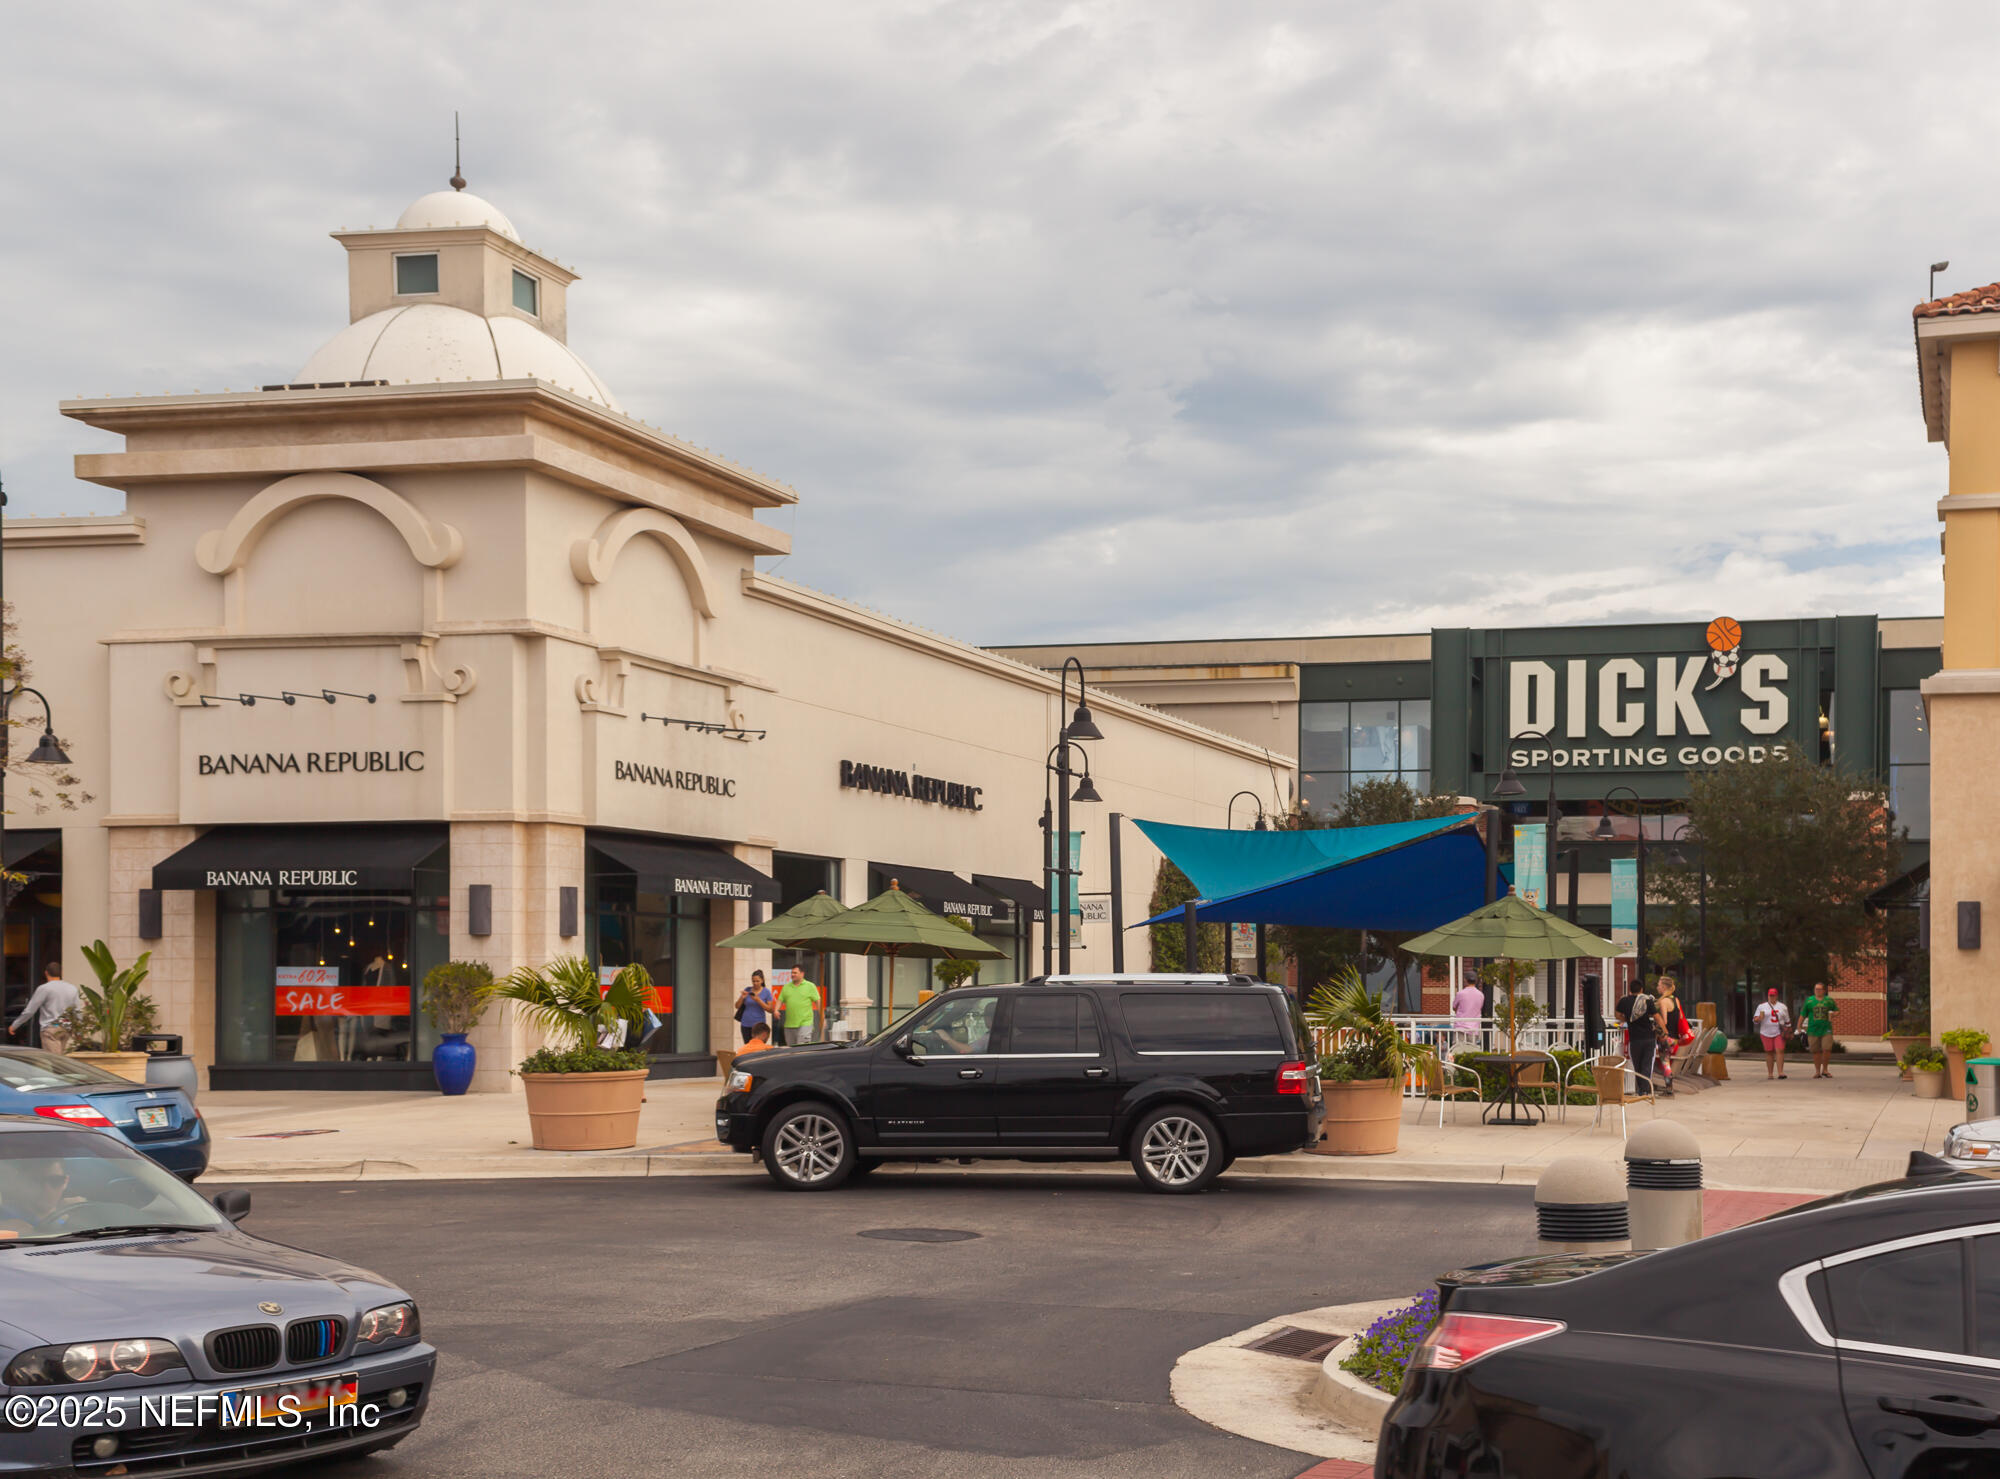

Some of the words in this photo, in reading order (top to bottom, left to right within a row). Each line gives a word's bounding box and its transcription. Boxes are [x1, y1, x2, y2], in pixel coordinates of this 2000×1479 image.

[1509, 654, 1789, 739] DICK'S
[199, 752, 301, 775] BANANA
[307, 750, 425, 773] REPUBLIC
[1511, 747, 1667, 768] SPORTING
[1677, 745, 1790, 766] GOODS
[615, 760, 674, 788] BANANA
[675, 770, 736, 798] REPUBLIC
[840, 759, 911, 798] BANANA
[912, 774, 983, 811] REPUBLIC
[206, 870, 272, 886] BANANA
[279, 870, 358, 886] REPUBLIC
[674, 878, 711, 895] BANANA
[712, 881, 752, 898] REPUBLIC
[943, 901, 967, 914] BANANA
[967, 903, 993, 917] REPUBLIC
[1033, 909, 1044, 920] BAN
[1079, 903, 1104, 911] NANA
[1082, 911, 1107, 920] UBLIC
[286, 991, 345, 1013] SALE
